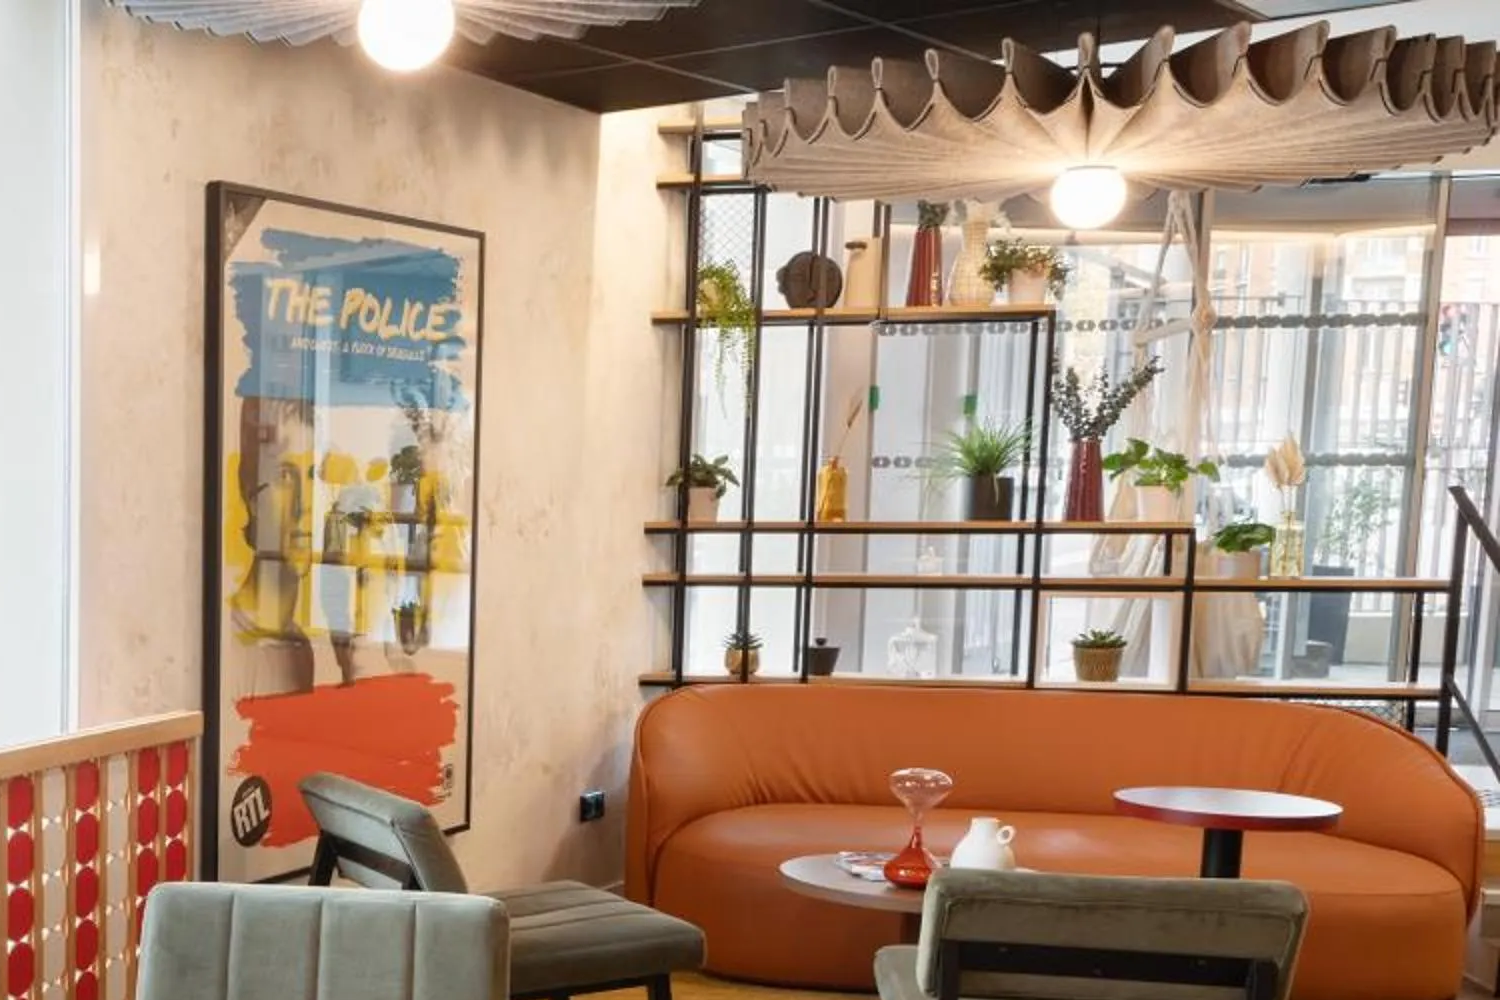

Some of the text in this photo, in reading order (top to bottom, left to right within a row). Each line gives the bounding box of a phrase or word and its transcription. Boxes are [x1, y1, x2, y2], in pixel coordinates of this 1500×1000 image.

[265, 277, 454, 342] THE POLICE
[233, 786, 270, 838] RTL
